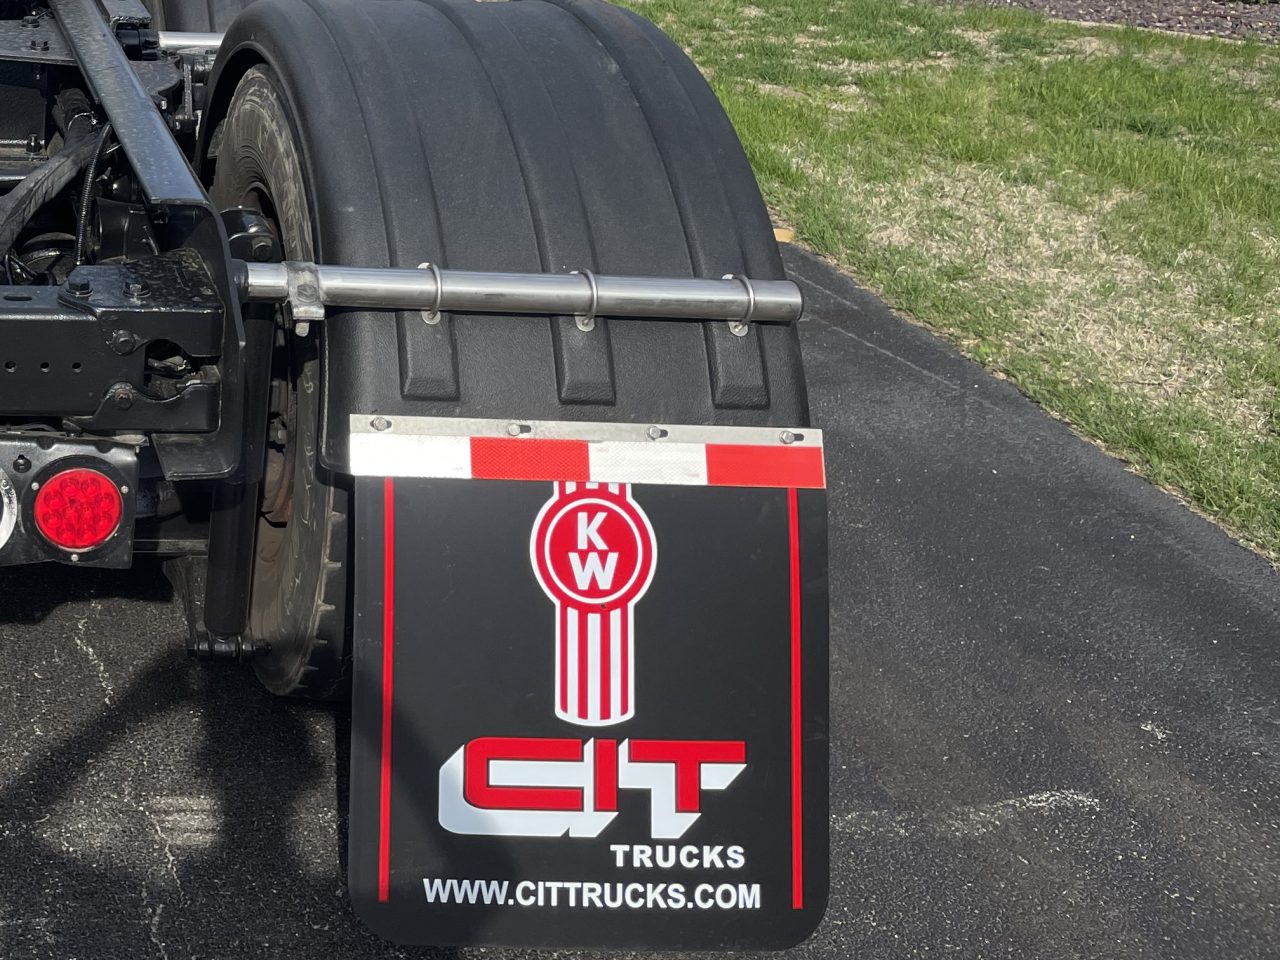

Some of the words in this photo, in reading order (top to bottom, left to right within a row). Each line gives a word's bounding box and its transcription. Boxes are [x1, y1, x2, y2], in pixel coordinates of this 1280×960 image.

[576, 511, 610, 551] K
[567, 551, 619, 591] W
[438, 736, 748, 839] CIT
[609, 844, 747, 869] TRUCKS
[423, 878, 762, 910] WWW.CITTRUCKS.COM
